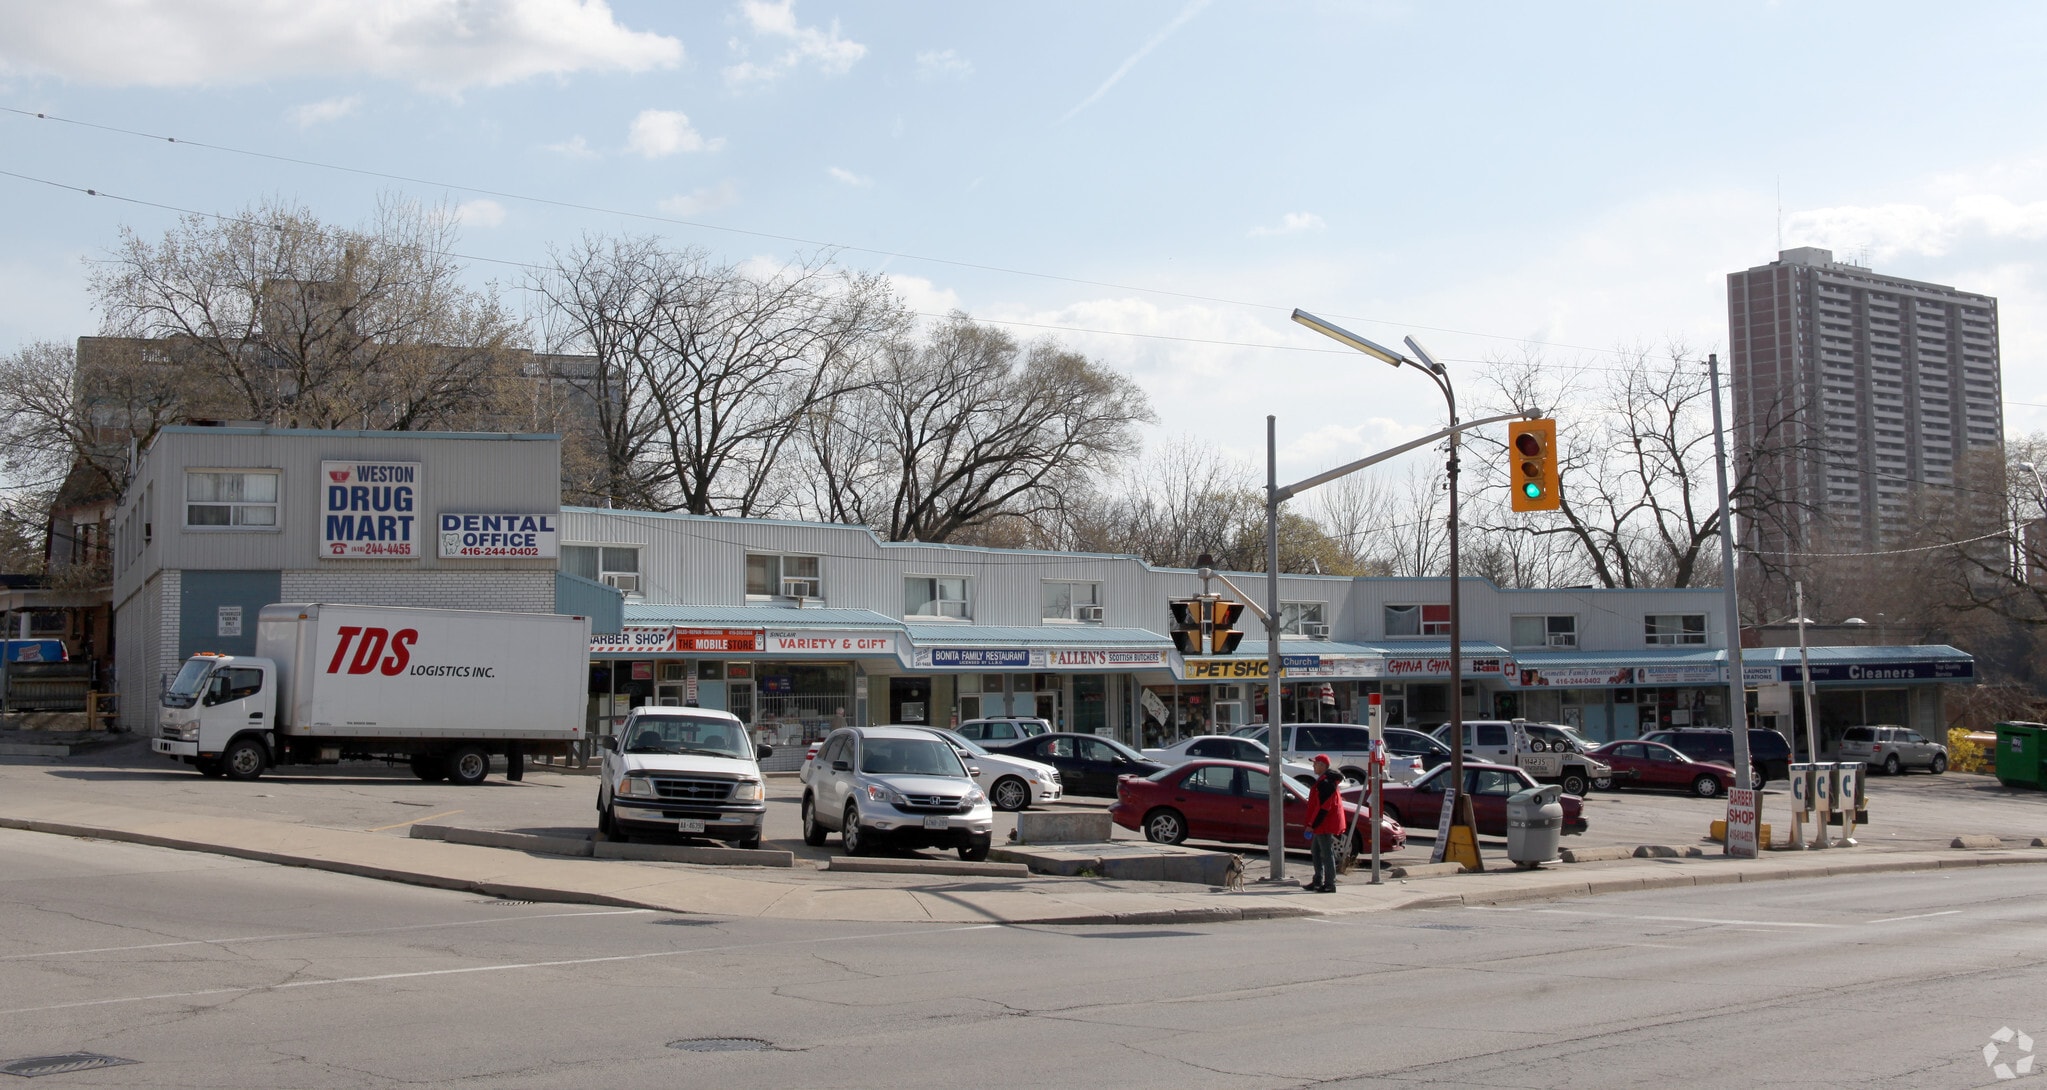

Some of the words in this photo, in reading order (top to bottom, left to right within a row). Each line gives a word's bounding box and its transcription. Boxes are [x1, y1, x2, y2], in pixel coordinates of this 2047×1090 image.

[357, 465, 414, 483] WESTON
[328, 485, 413, 512] DRUG
[326, 515, 415, 541] MART
[442, 515, 555, 532] DENTAL
[463, 533, 536, 547] OFFICE
[365, 543, 411, 555] 244-4455
[460, 547, 539, 556] 416-244-0402
[590, 634, 630, 645] ARBER
[635, 634, 666, 645] SHOP
[678, 639, 693, 649] THE
[778, 638, 837, 649] VARIETY
[842, 639, 852, 649] &
[857, 639, 887, 649] GIFT
[326, 626, 419, 676] TDS
[935, 650, 960, 661] BONITA
[961, 651, 983, 661] FAMILY
[985, 651, 1026, 661] RESTAURANT
[1058, 650, 1106, 665] ALLEN'S
[1108, 653, 1133, 662] SCOTTISH
[1134, 653, 1159, 661] BUTCHERS
[1283, 657, 1312, 666] Church
[1388, 659, 1422, 675] CHINA
[410, 665, 470, 677] LOGISTICS
[472, 667, 495, 678] INC.
[1196, 662, 1232, 677] PET
[1234, 661, 1283, 676] SHO
[1568, 669, 1588, 677] Family
[1591, 667, 1617, 676] Dentistry
[1849, 665, 1915, 679] Cleaners
[1729, 789, 1753, 806] BARBER
[1729, 808, 1755, 825] SHOP
